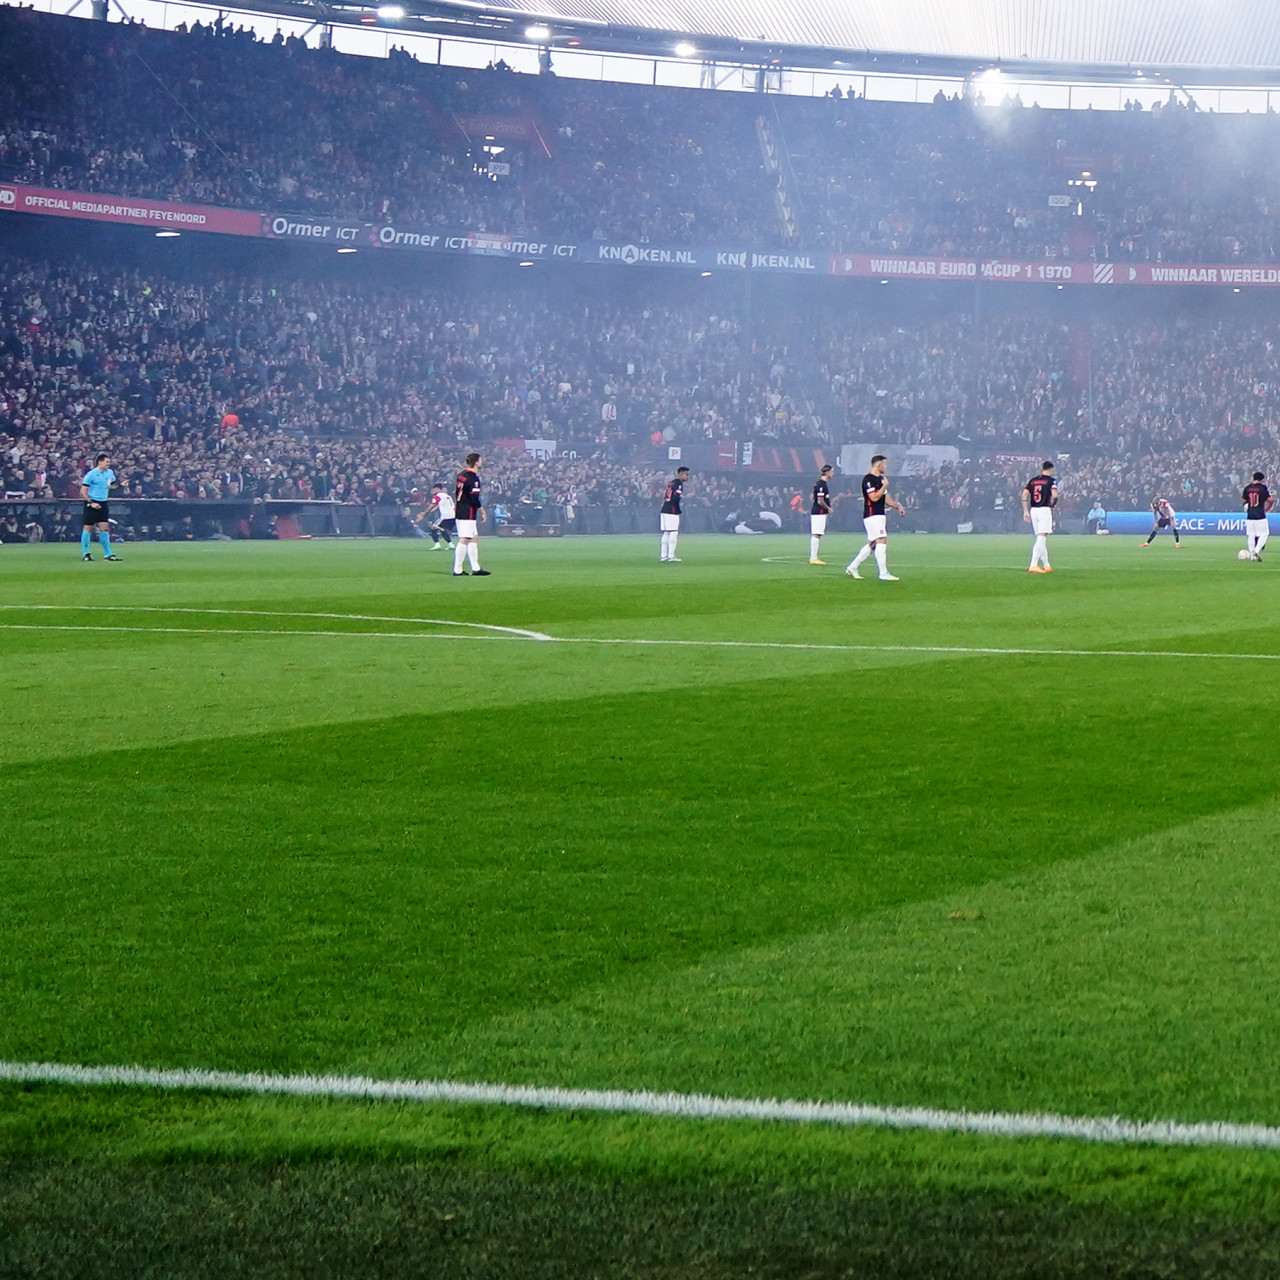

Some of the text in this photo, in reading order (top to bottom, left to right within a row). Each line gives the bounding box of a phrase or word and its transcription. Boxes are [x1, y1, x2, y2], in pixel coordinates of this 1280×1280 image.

[25, 195, 206, 225] OFFICIAL MEDIAPARTNER FEYENOORD
[272, 217, 359, 240] Ormer ICT
[379, 226, 440, 247] Ormer
[444, 236, 468, 249] ICT
[552, 245, 577, 257] ICT
[717, 252, 816, 269] KNKEN.NL
[870, 259, 936, 274] WINNAAR
[1037, 265, 1073, 279] 1970
[1151, 268, 1217, 282] WINNAAR
[1033, 485, 1042, 503] 5
[1249, 492, 1260, 507] 10
